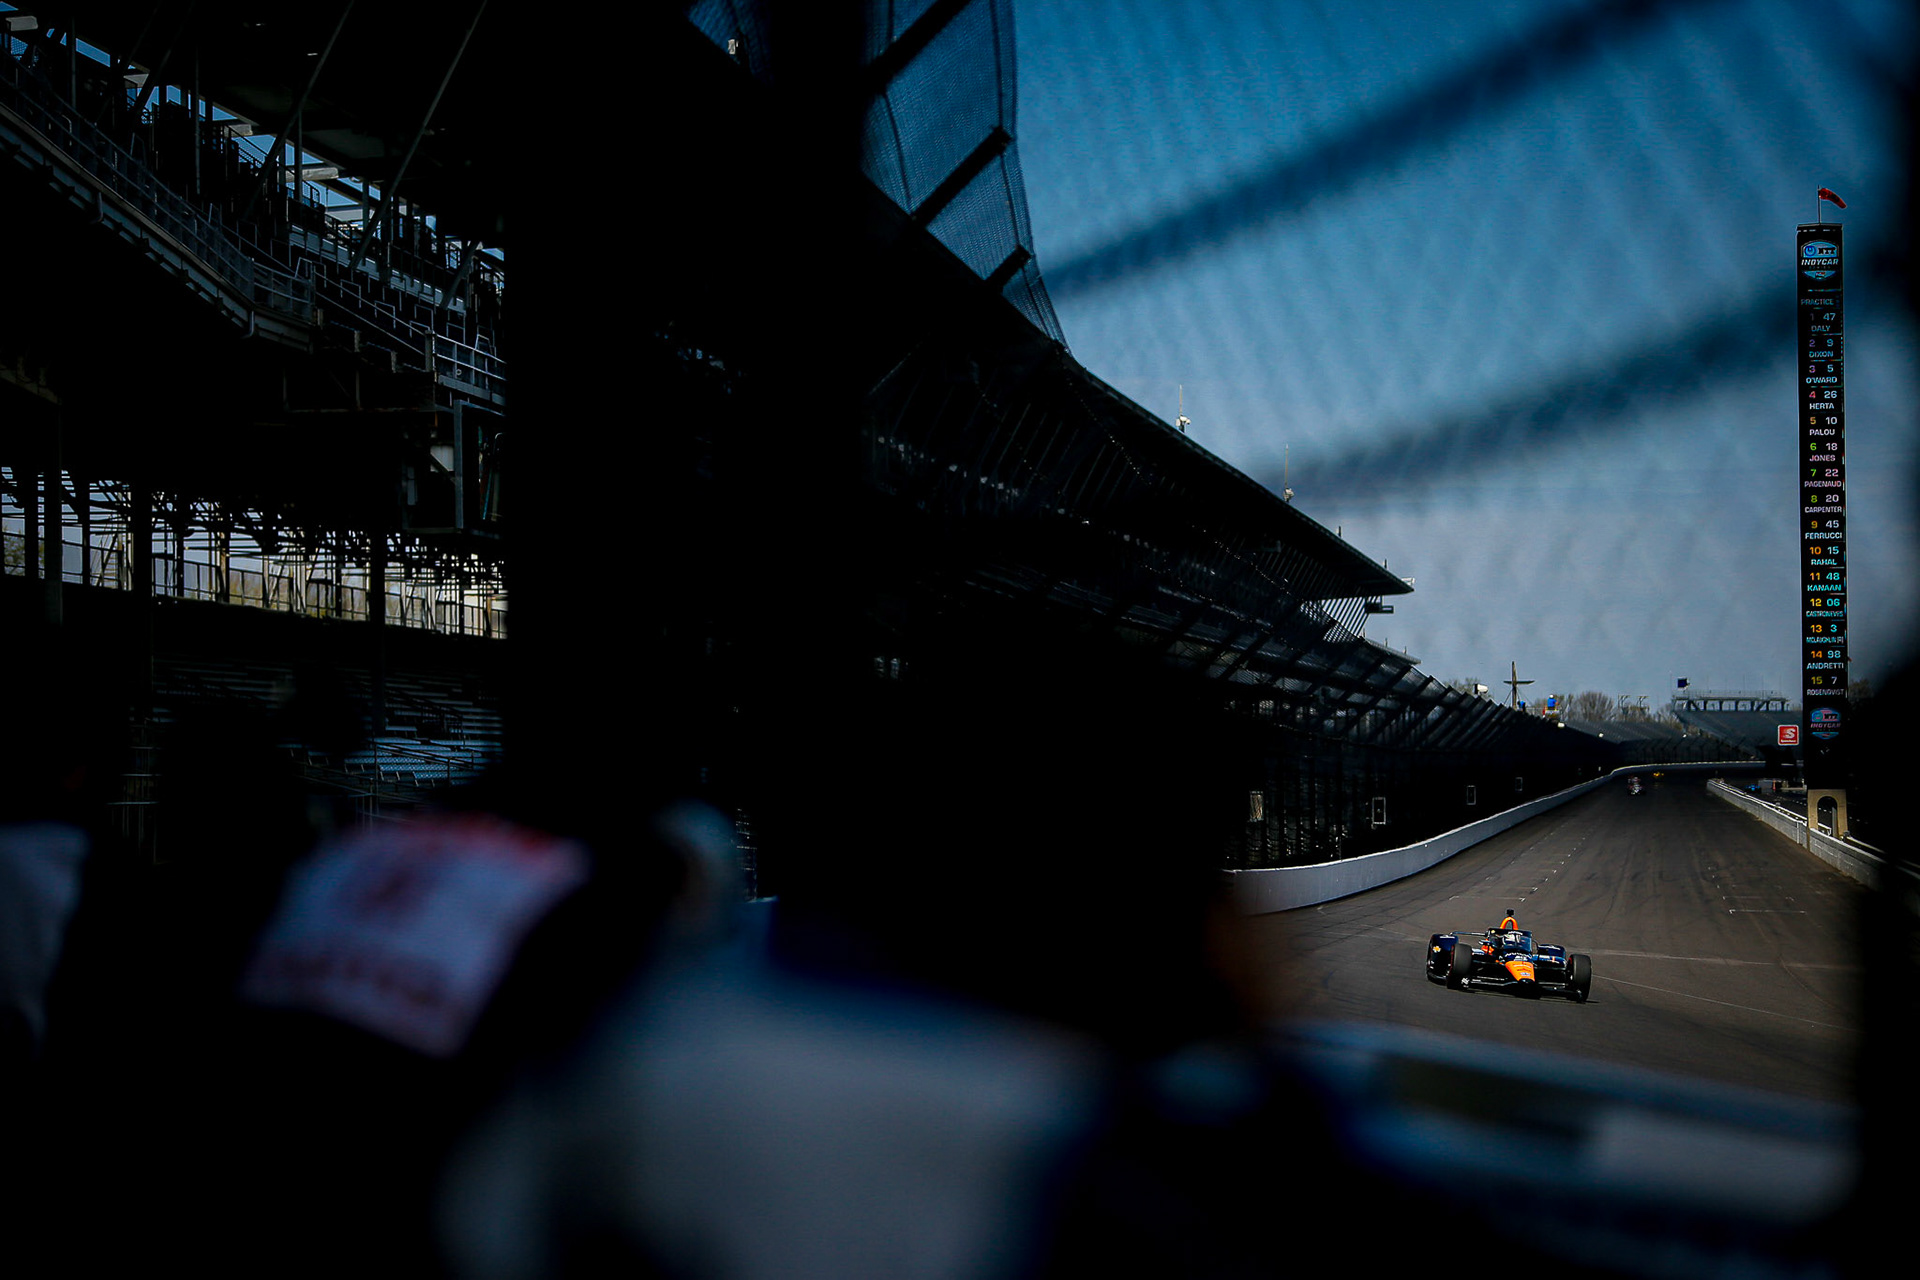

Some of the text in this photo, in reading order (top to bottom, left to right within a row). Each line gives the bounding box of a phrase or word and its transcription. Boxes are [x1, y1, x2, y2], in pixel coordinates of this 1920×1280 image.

[1810, 598, 1840, 606] 12 06
[1810, 624, 1838, 633] 13 3
[1811, 650, 1841, 658] 14 98
[1811, 676, 1837, 684] 15 7
